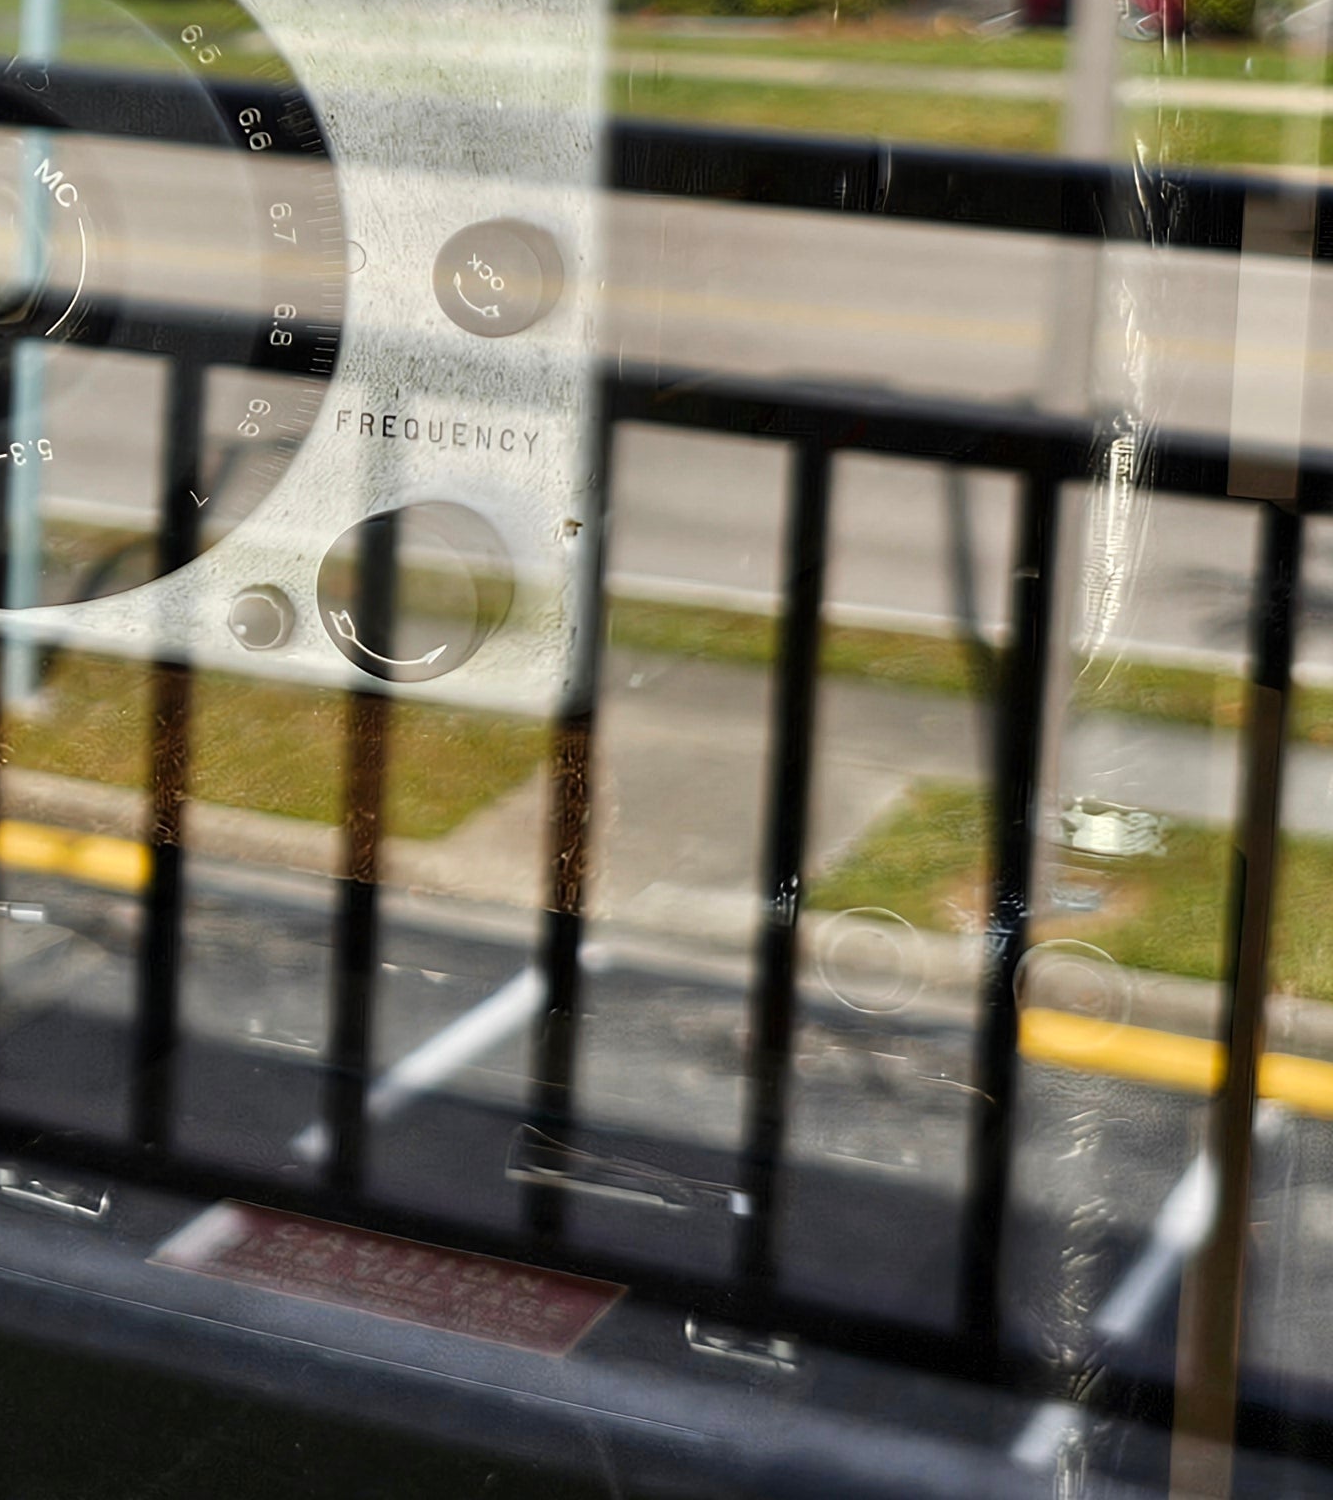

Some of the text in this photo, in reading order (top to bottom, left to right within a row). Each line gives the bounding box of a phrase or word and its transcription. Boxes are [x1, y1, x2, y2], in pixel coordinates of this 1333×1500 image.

[181, 24, 222, 66] 6.5
[238, 107, 273, 151] 6.6
[33, 158, 78, 207] MC
[269, 202, 297, 244] 6.7
[467, 252, 504, 291] OCK
[269, 304, 296, 346] 6.8
[237, 398, 271, 438] 6.9
[334, 409, 543, 455] FREQUENCY
